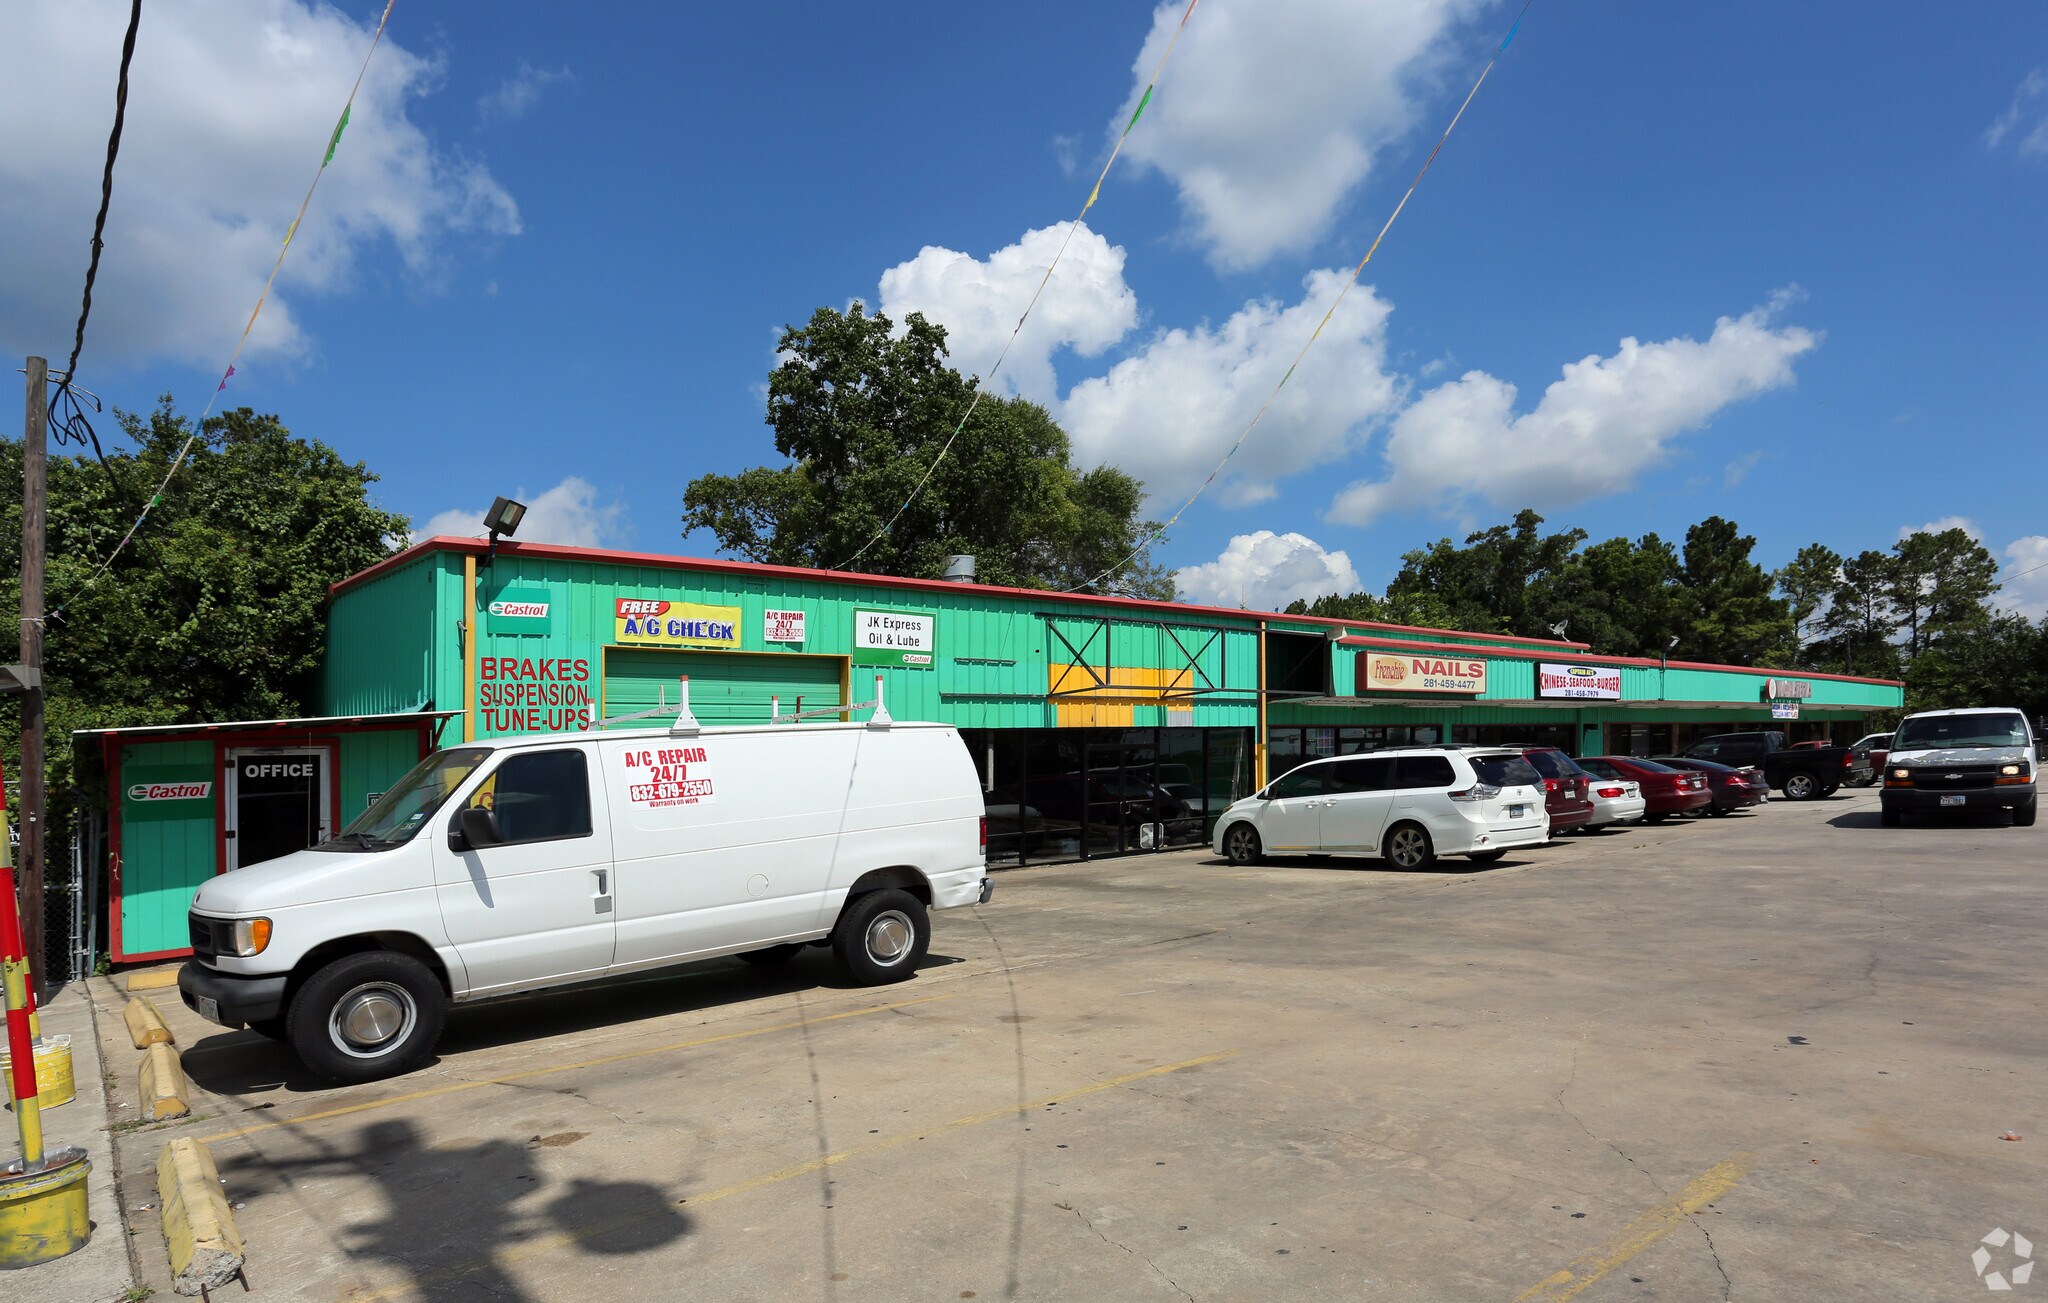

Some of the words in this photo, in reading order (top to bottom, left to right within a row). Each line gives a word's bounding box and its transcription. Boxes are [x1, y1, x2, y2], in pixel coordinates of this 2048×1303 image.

[504, 603, 545, 616] Castrol
[620, 601, 660, 614] FREE
[766, 611, 779, 620] A/C
[780, 612, 804, 621] REPAIR
[867, 616, 880, 628] JK
[883, 617, 922, 631] Express
[624, 614, 661, 636] A/C
[667, 617, 735, 640] CHECK
[775, 620, 793, 629] 24/7
[869, 632, 882, 644] Oil
[886, 634, 893, 645] &
[897, 634, 920, 647] Lube
[909, 655, 930, 663] Castrol
[481, 657, 589, 681] BRAKES
[1374, 660, 1405, 680] Frenchie
[1412, 658, 1484, 678] NAILS
[1423, 678, 1476, 689] 281-459-4477
[480, 683, 588, 706] SUSPENSION
[481, 708, 589, 731] TUNE-UPS
[625, 750, 652, 767] A/C
[657, 747, 707, 765] REPAIR
[244, 763, 314, 778] OFFICE
[650, 764, 687, 783] 24/7
[149, 783, 206, 798] Castrol
[631, 780, 712, 801] 832-679-2550
[649, 798, 676, 808] Warranty
[685, 796, 699, 804] work
